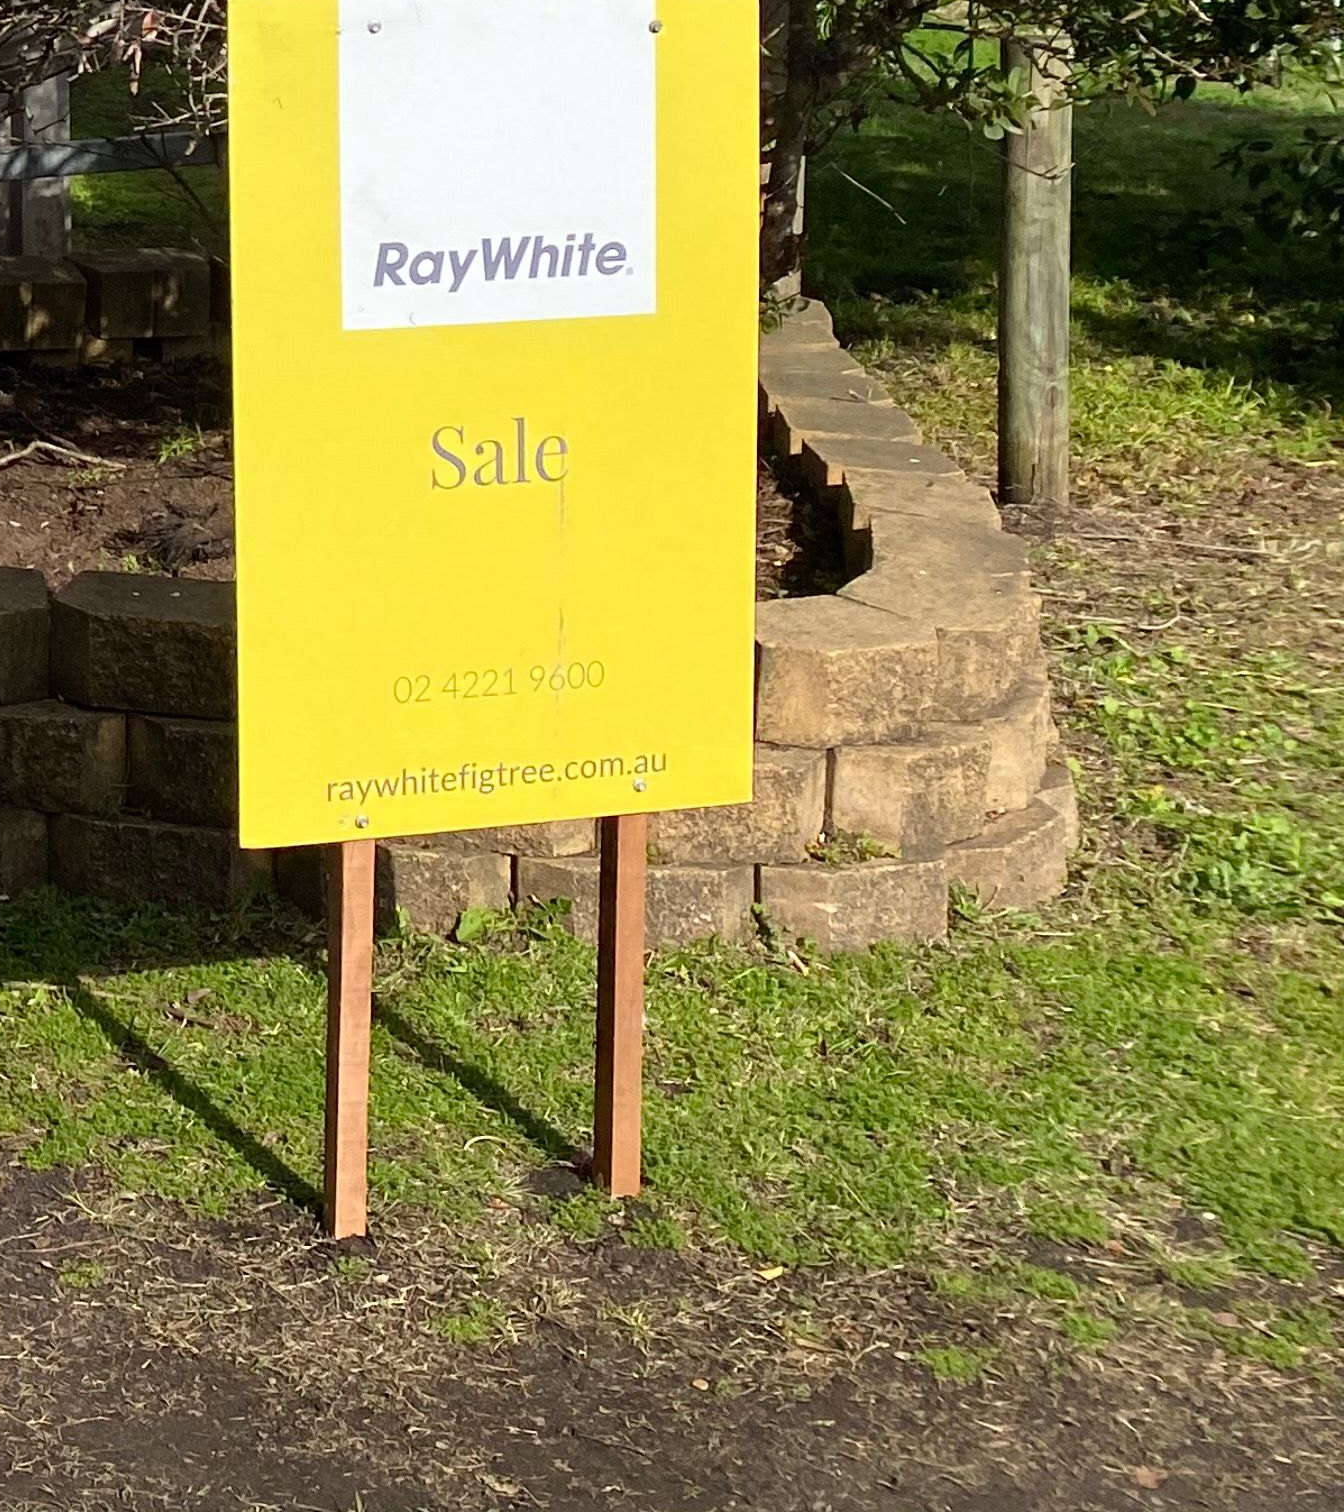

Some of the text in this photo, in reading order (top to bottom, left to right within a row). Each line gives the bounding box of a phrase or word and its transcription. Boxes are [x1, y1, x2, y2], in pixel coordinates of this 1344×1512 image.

[431, 416, 569, 490] Sale
[393, 660, 605, 704] 02 4221 9600
[326, 752, 667, 805] raywhitefigtree.com.au
